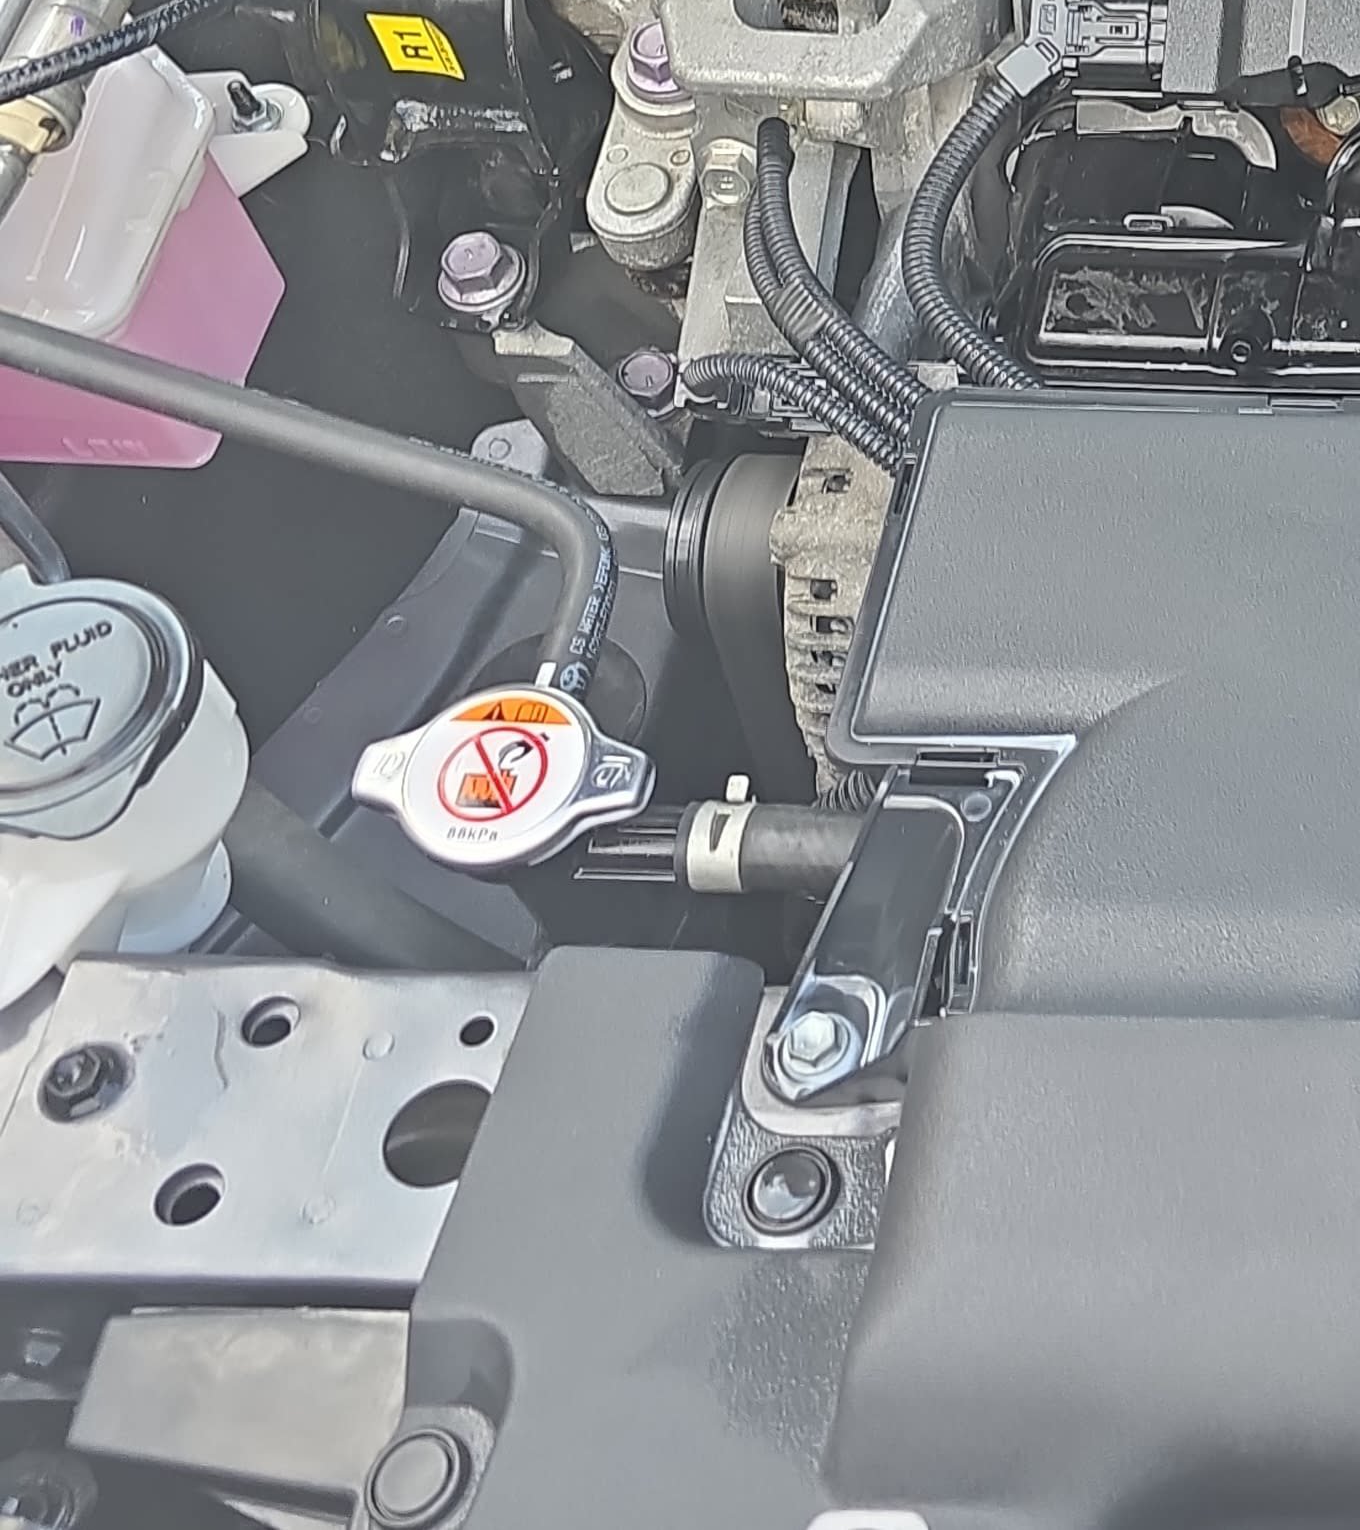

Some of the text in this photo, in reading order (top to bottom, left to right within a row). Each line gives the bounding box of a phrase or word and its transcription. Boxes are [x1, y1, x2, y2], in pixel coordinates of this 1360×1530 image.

[393, 30, 434, 60] R1
[49, 620, 113, 659] FLUID
[7, 662, 63, 698] ONLY
